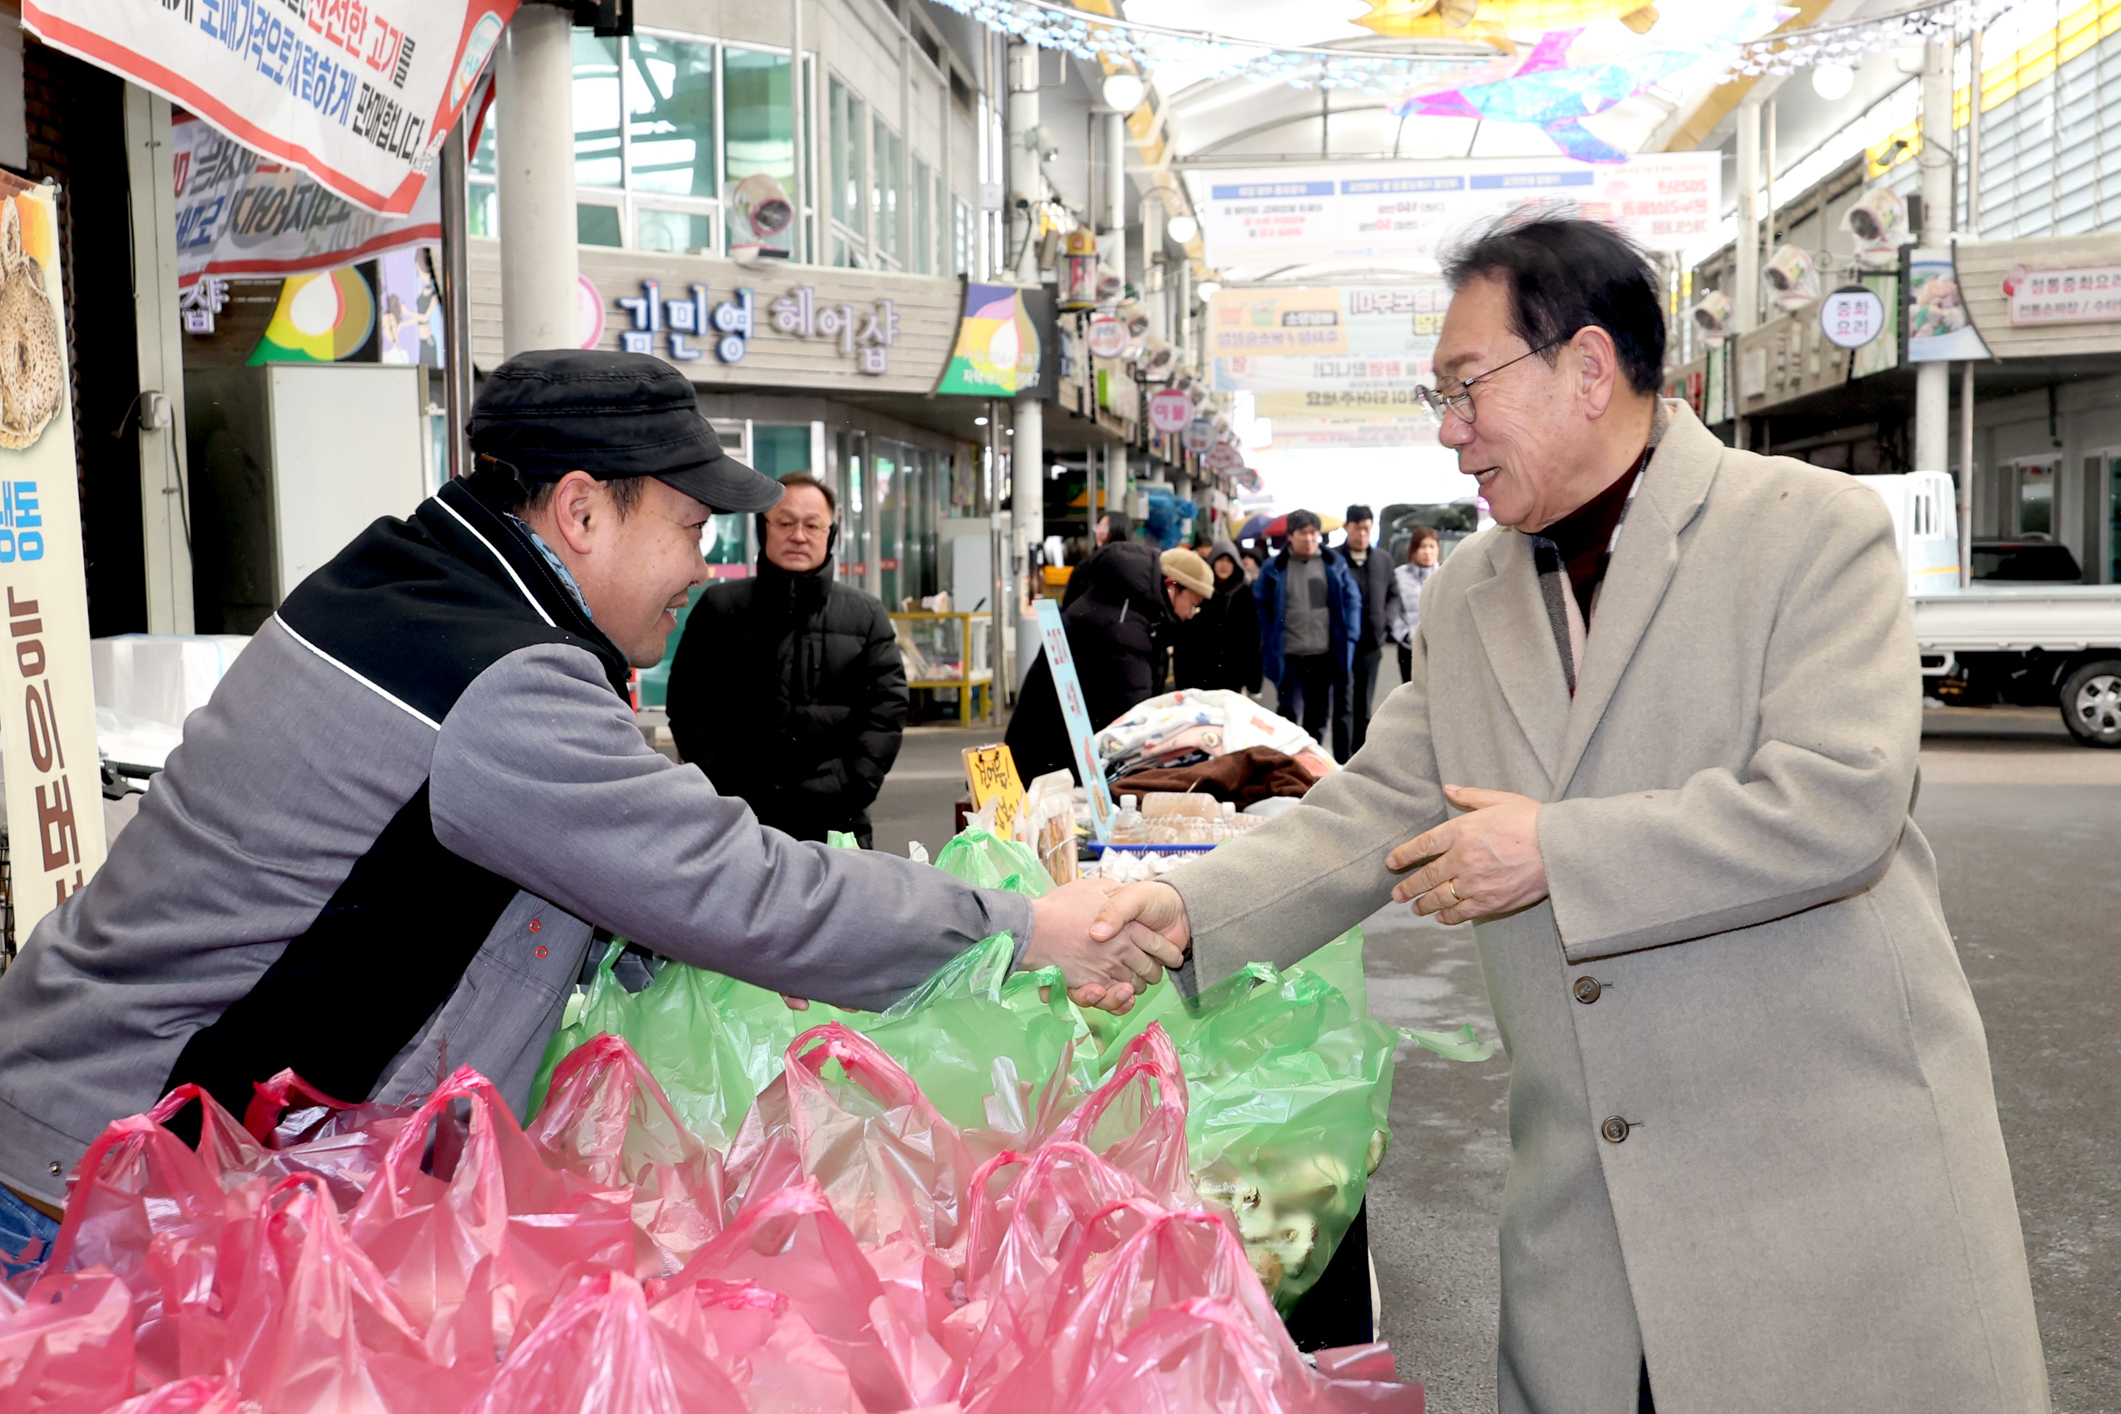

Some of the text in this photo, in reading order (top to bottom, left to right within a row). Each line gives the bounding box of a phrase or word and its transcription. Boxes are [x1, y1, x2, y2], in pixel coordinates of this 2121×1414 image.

[366, 15, 416, 89] 고기를
[614, 278, 901, 375] 김민영 헤어샵
[1836, 319, 1868, 335] 요리
[1837, 300, 1869, 317] 중화
